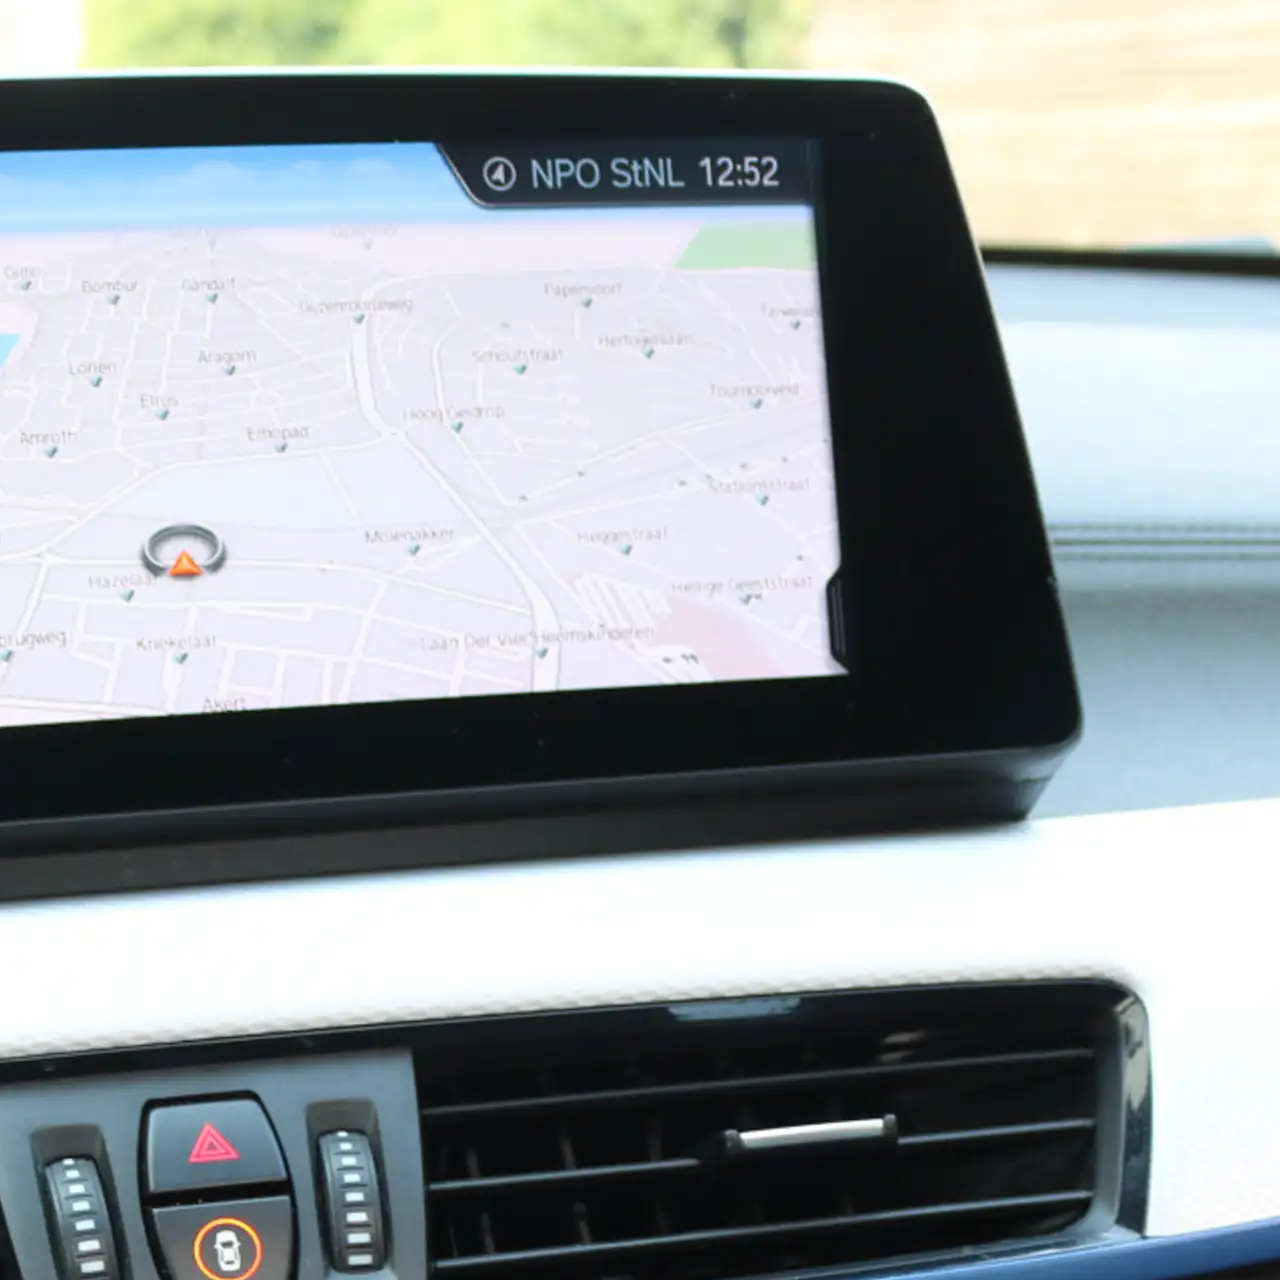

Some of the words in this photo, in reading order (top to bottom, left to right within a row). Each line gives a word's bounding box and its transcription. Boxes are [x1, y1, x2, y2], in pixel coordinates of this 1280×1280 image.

[530, 157, 601, 189] NPO
[611, 156, 685, 188] StNL
[699, 155, 780, 187] 12:52
